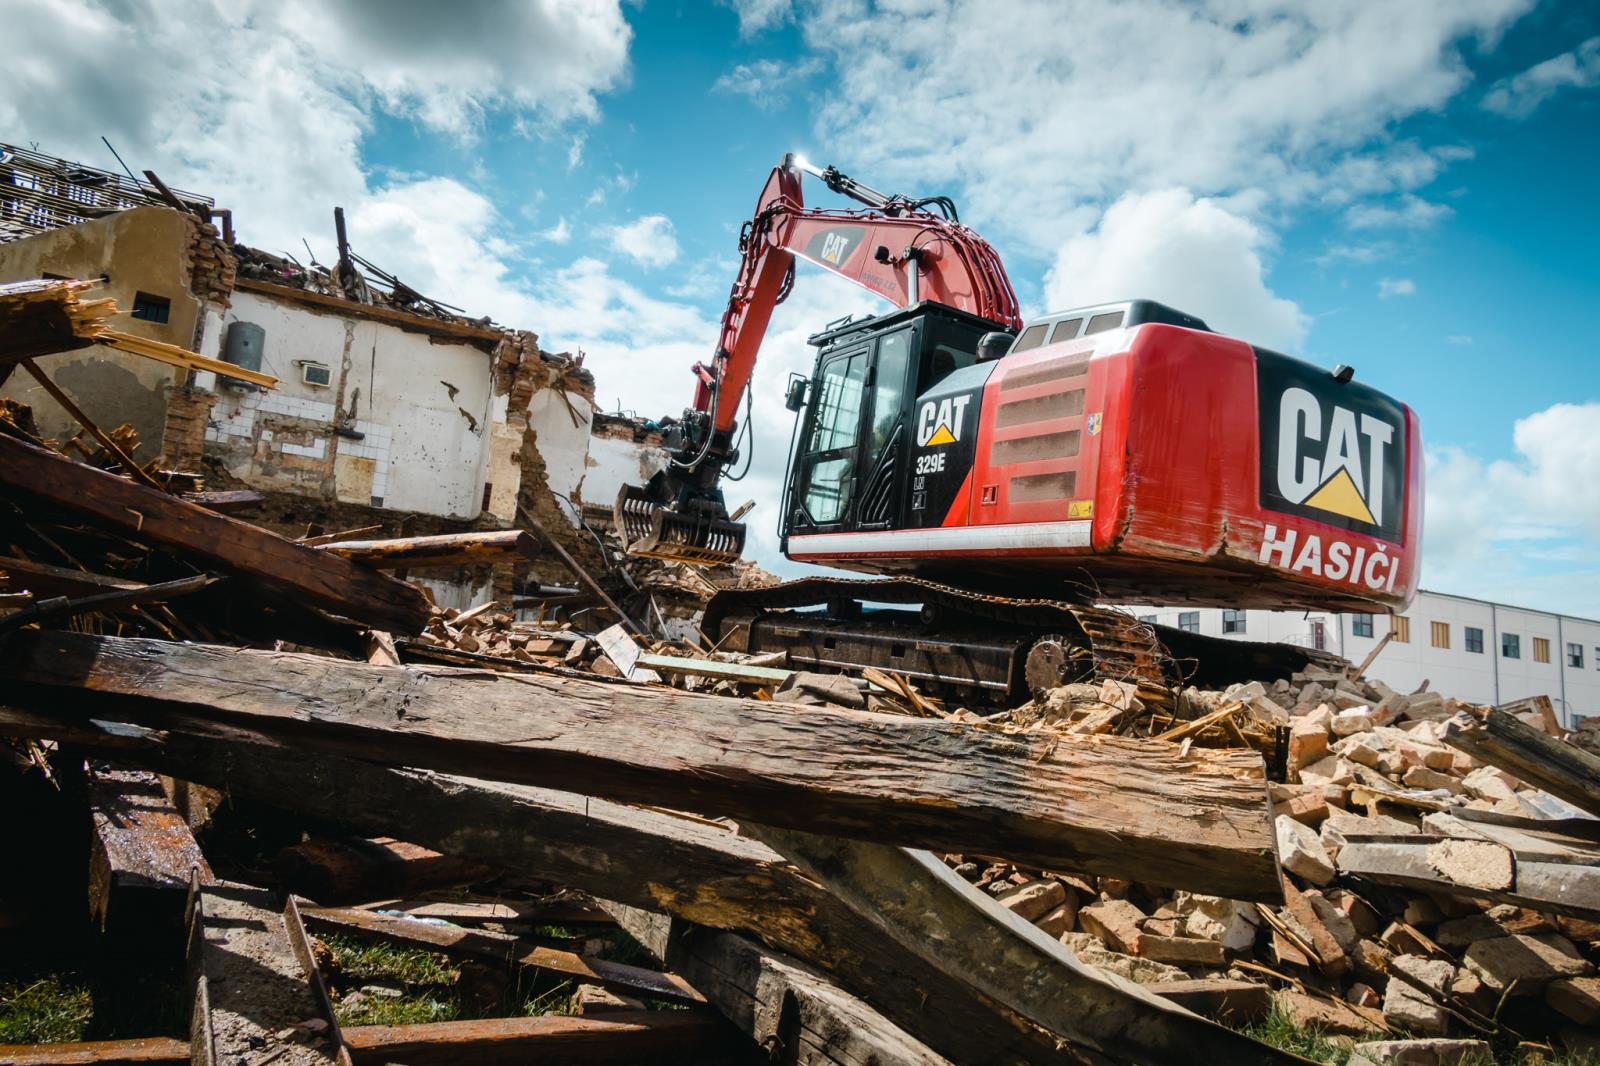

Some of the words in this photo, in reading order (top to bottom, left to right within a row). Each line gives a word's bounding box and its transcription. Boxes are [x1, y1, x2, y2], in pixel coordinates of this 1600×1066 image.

[821, 232, 849, 264] CAT
[917, 394, 970, 447] CAT
[916, 453, 946, 474] 329E
[1277, 387, 1394, 527] CAT
[1258, 524, 1400, 592] HASIČI
